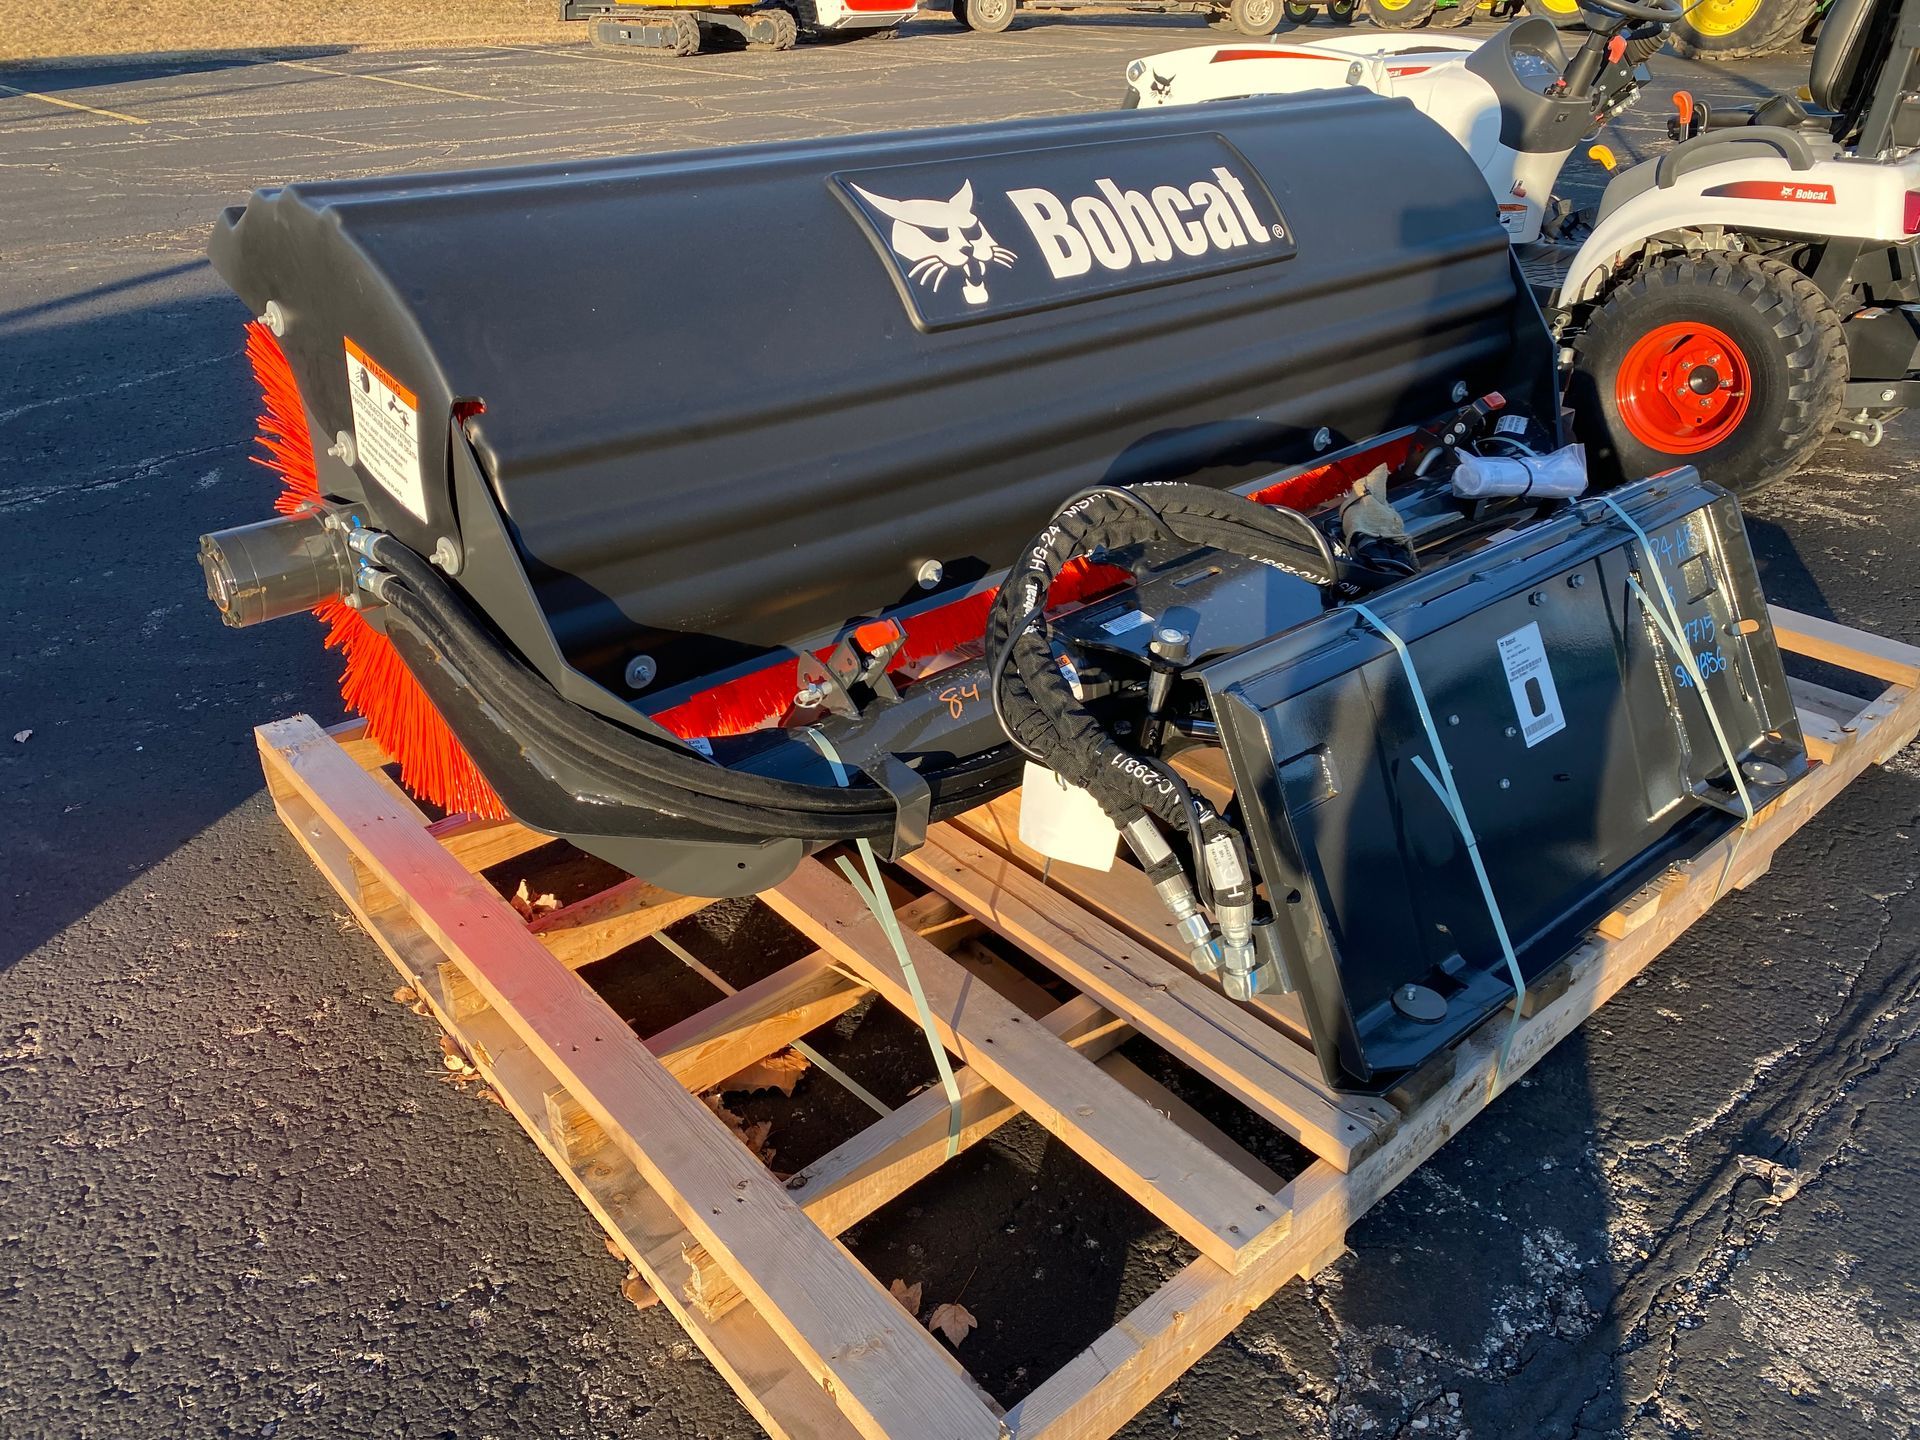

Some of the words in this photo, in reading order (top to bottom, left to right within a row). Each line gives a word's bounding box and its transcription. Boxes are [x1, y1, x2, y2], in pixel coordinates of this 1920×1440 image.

[1795, 188, 1828, 200] Bobcat
[1006, 167, 1271, 279] Bobcat
[370, 361, 401, 395] WARNING
[1030, 524, 1061, 571] HG-24
[939, 683, 980, 720] 84
